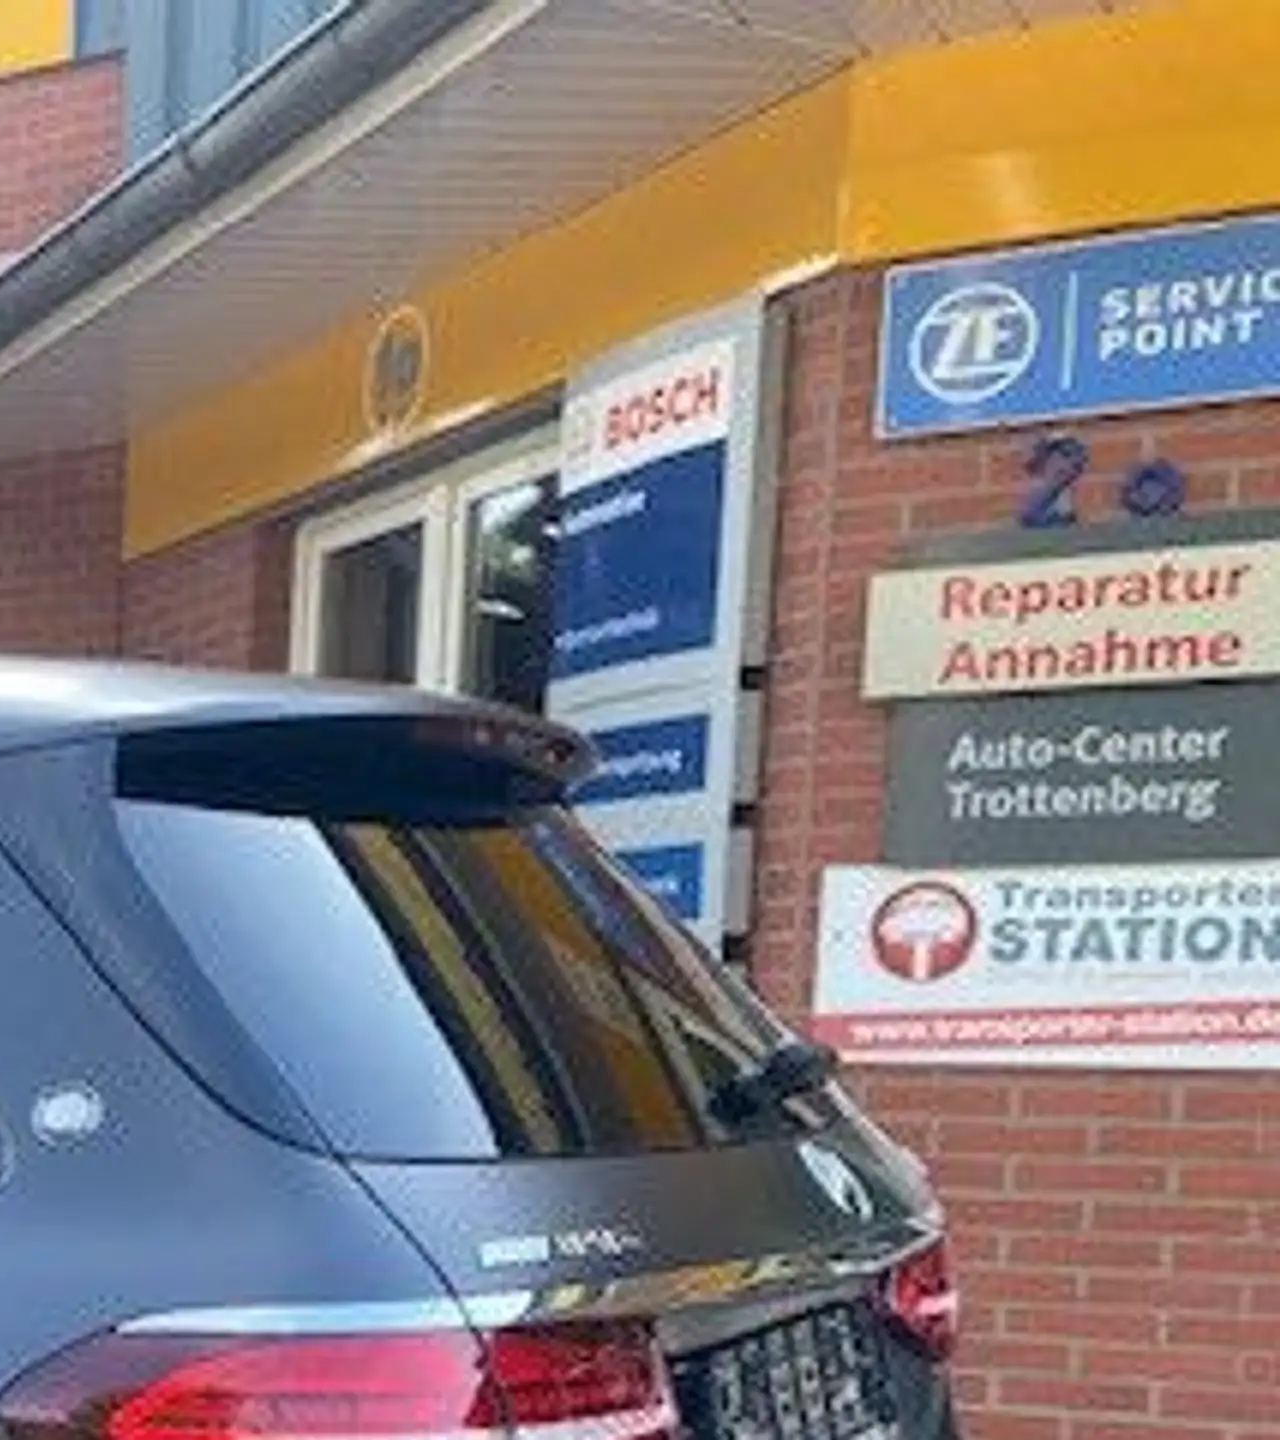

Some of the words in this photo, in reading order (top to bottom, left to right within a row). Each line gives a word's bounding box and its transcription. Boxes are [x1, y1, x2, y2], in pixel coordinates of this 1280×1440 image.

[1099, 308, 1264, 361] POINT
[606, 366, 721, 449] BOSCH
[940, 563, 1252, 624] Reparatur
[938, 630, 1242, 684] Annahme
[948, 725, 1231, 771] Auto-Center
[944, 774, 1222, 822] Trottenberg
[990, 916, 1280, 962] STATION
